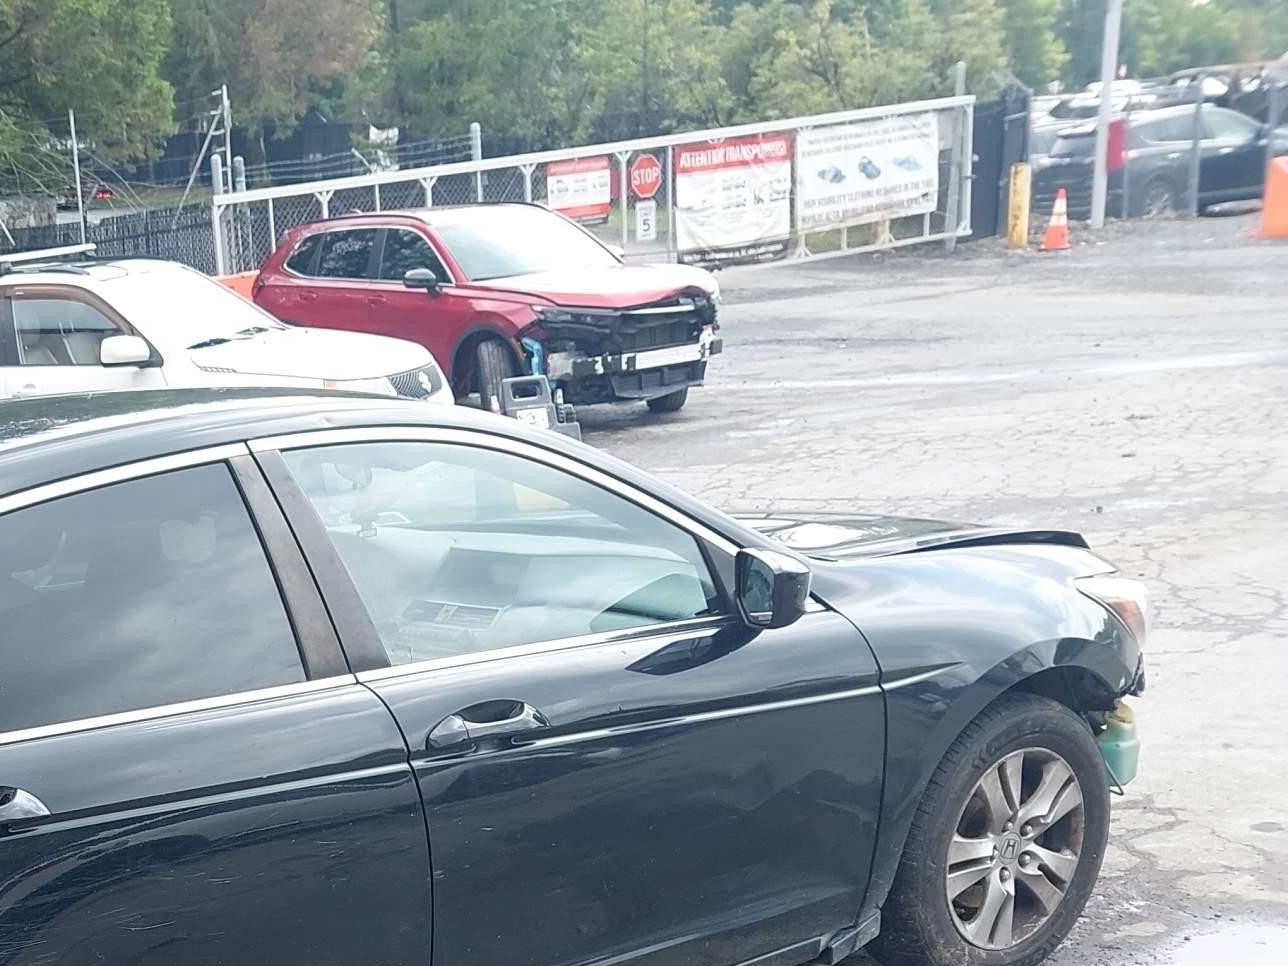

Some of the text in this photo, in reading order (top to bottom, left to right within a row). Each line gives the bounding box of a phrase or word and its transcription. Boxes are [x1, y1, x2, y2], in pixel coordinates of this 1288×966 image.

[680, 146, 725, 168] ATTENTION
[632, 167, 660, 186] STOP
[641, 217, 652, 233] 5
